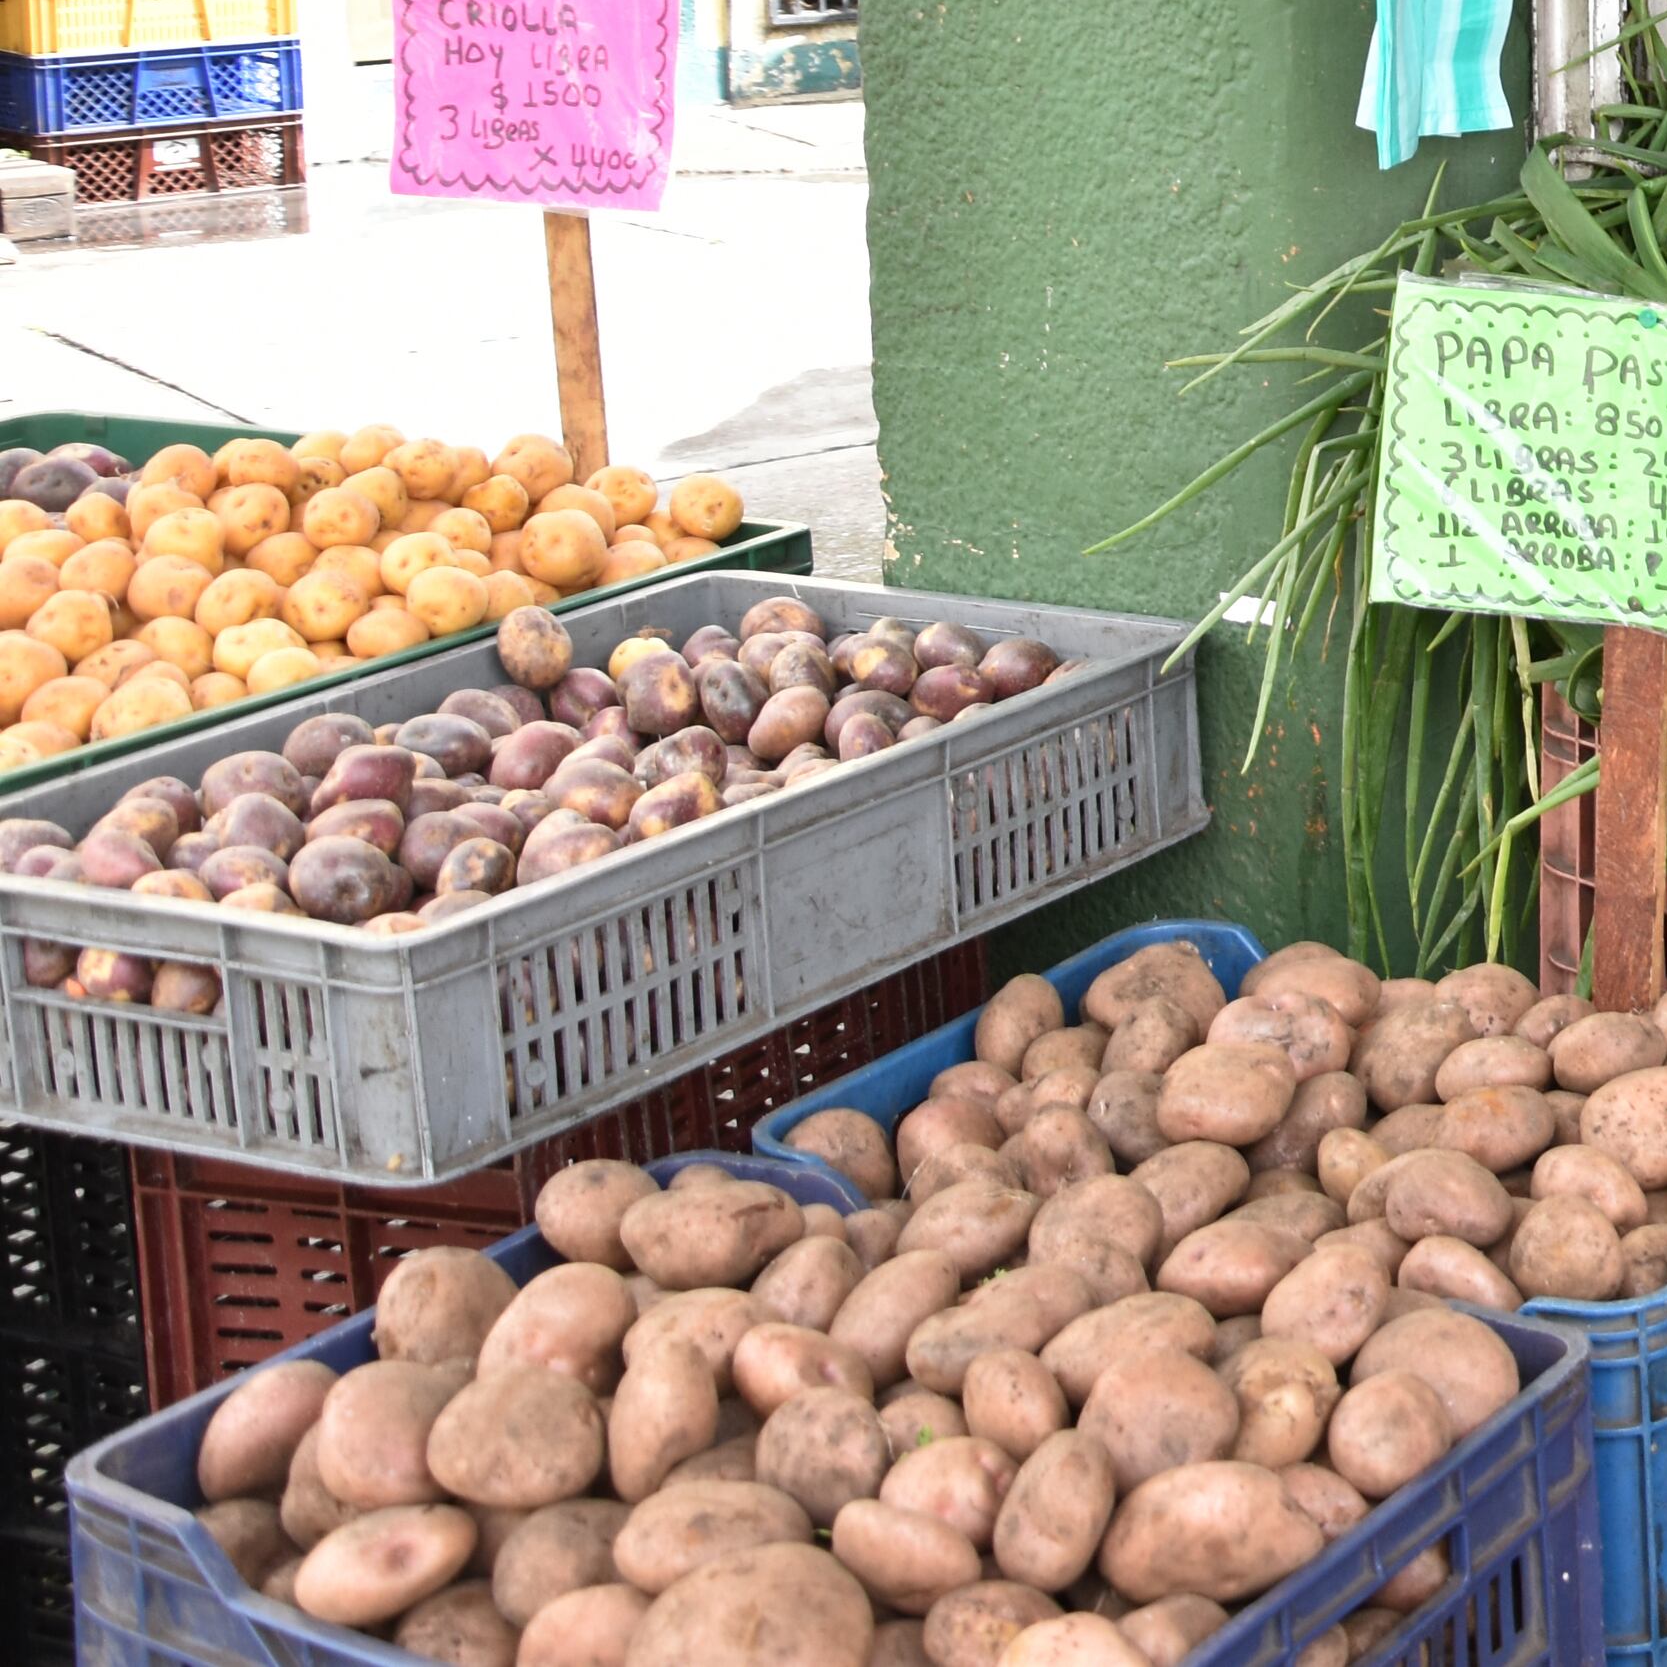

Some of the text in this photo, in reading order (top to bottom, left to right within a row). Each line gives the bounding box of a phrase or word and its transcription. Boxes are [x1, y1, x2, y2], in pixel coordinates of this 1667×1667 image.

[444, 35, 609, 80] HOY LIBRA
[490, 80, 603, 115] $ 1500
[438, 104, 460, 141] 3
[571, 142, 638, 181] 4400
[1434, 330, 1556, 387] PAPA
[1594, 401, 1663, 439] 850
[1441, 441, 1467, 474] 3
